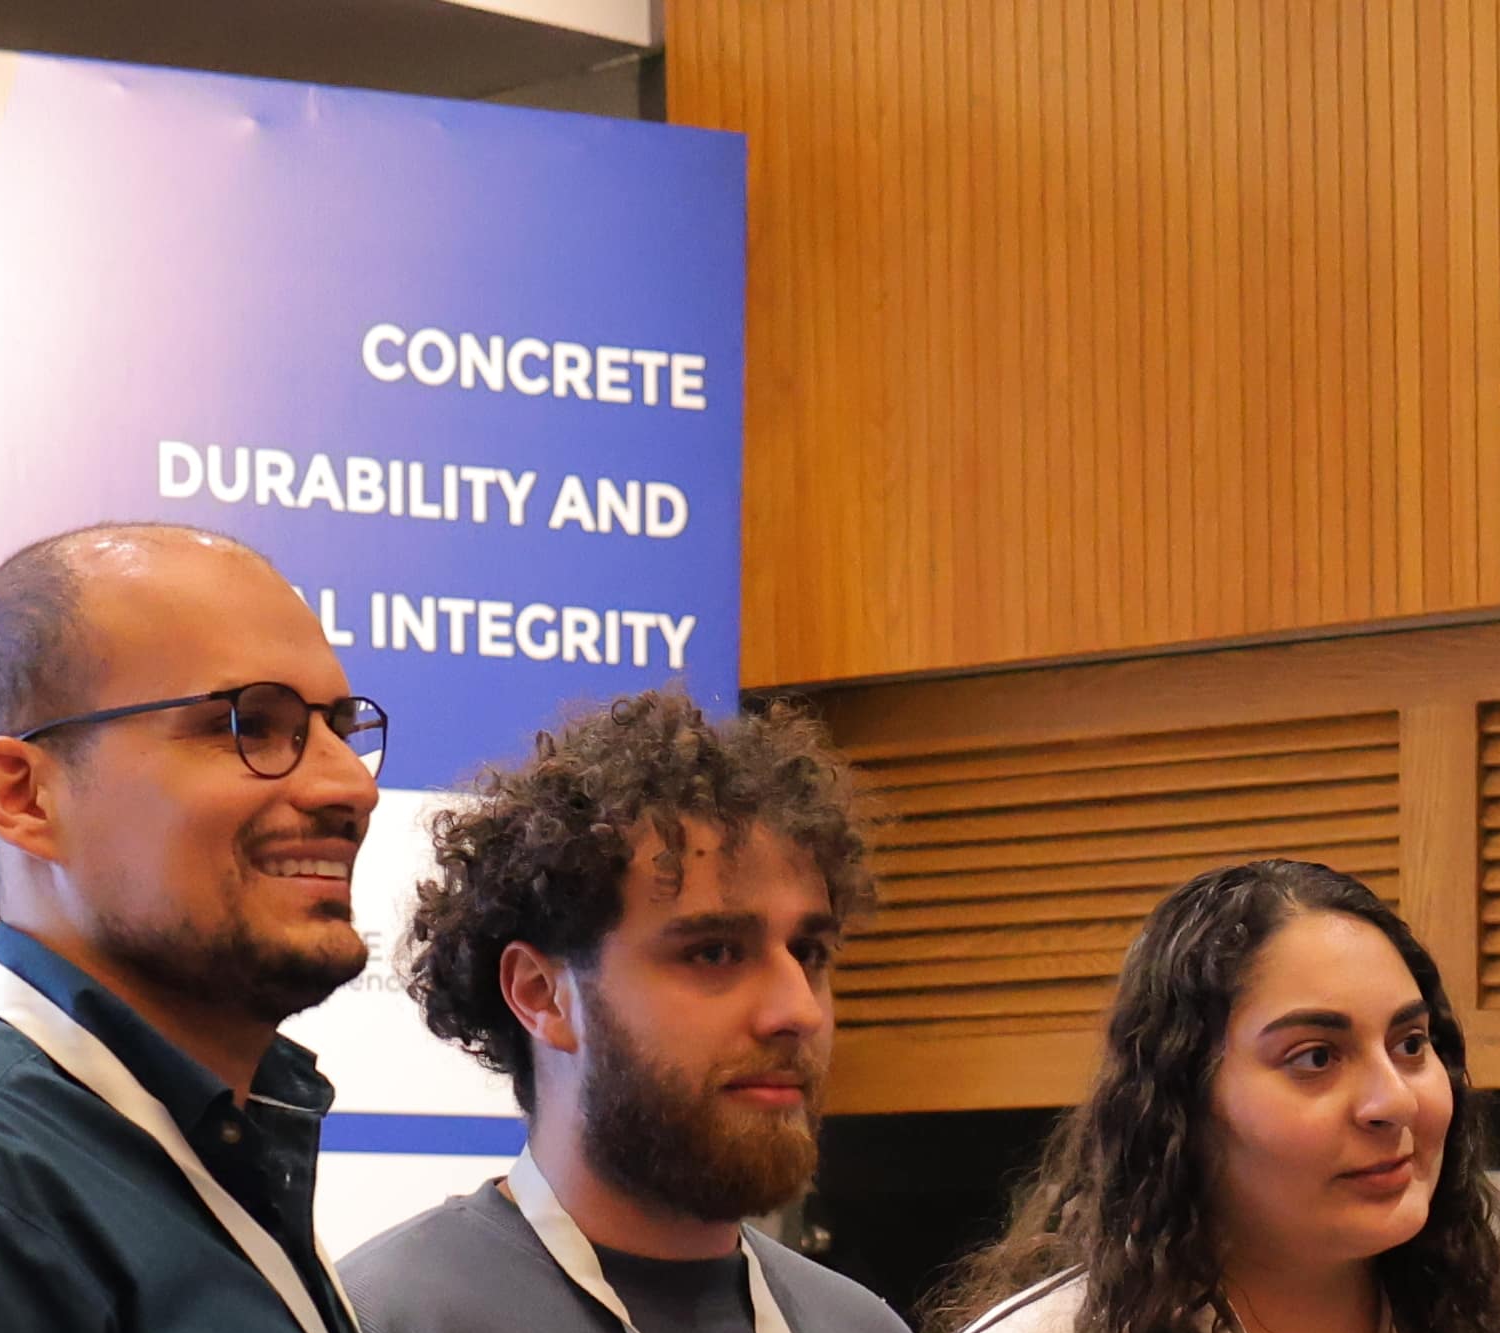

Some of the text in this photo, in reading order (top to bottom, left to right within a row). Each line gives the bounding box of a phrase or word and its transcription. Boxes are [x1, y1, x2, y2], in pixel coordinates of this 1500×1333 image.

[362, 323, 708, 410] CONCRETE
[158, 440, 690, 540] DURABILITY AND
[372, 592, 697, 671] INTEGRITY
